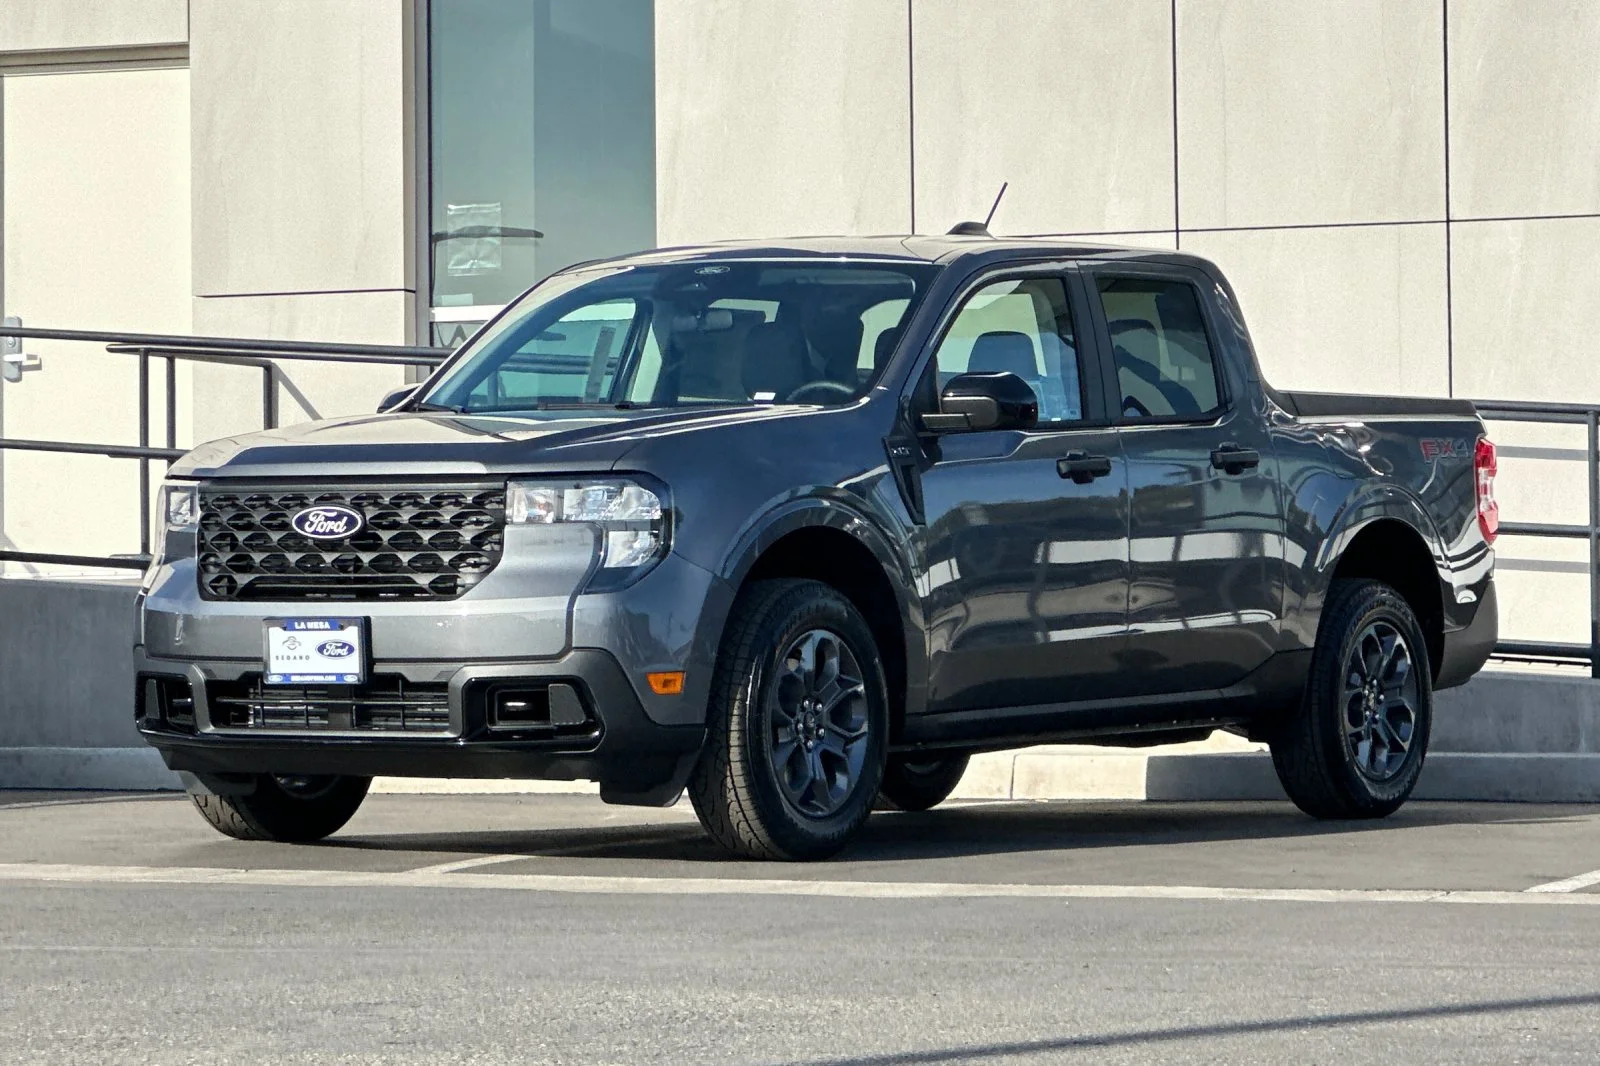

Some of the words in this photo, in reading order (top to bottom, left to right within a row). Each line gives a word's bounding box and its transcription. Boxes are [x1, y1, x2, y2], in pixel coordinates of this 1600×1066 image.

[1420, 438, 1469, 463] FX4
[304, 510, 348, 533] Ford
[294, 621, 307, 629] LA
[306, 621, 331, 630] MESA
[323, 642, 348, 656] Ford
